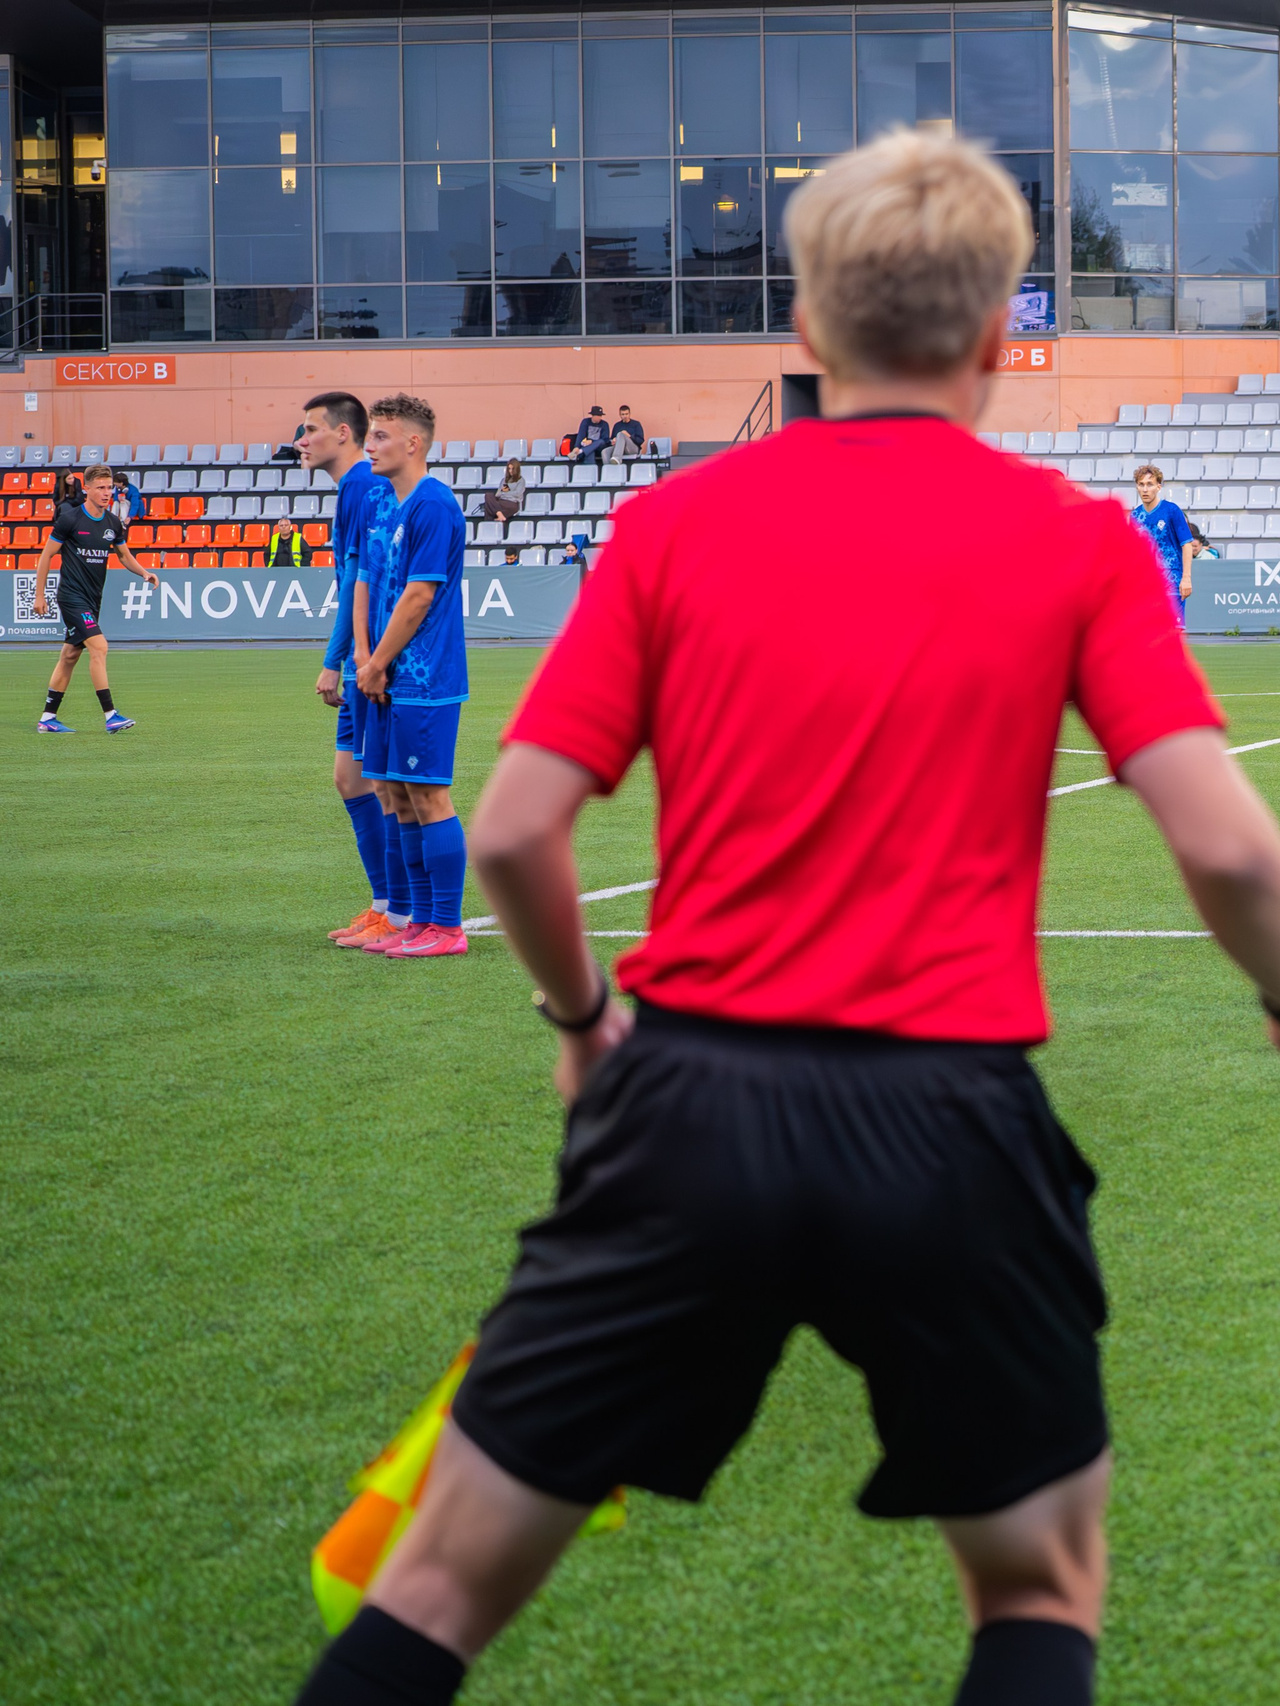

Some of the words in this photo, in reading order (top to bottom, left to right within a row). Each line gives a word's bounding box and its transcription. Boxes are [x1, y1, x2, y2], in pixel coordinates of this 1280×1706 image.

[1030, 348, 1046, 366] Б
[63, 362, 148, 381] СЕКТОР
[153, 362, 168, 379] В
[1214, 592, 1266, 605] NOVA
[1227, 606, 1275, 615] СПОРТИВНЫЙ
